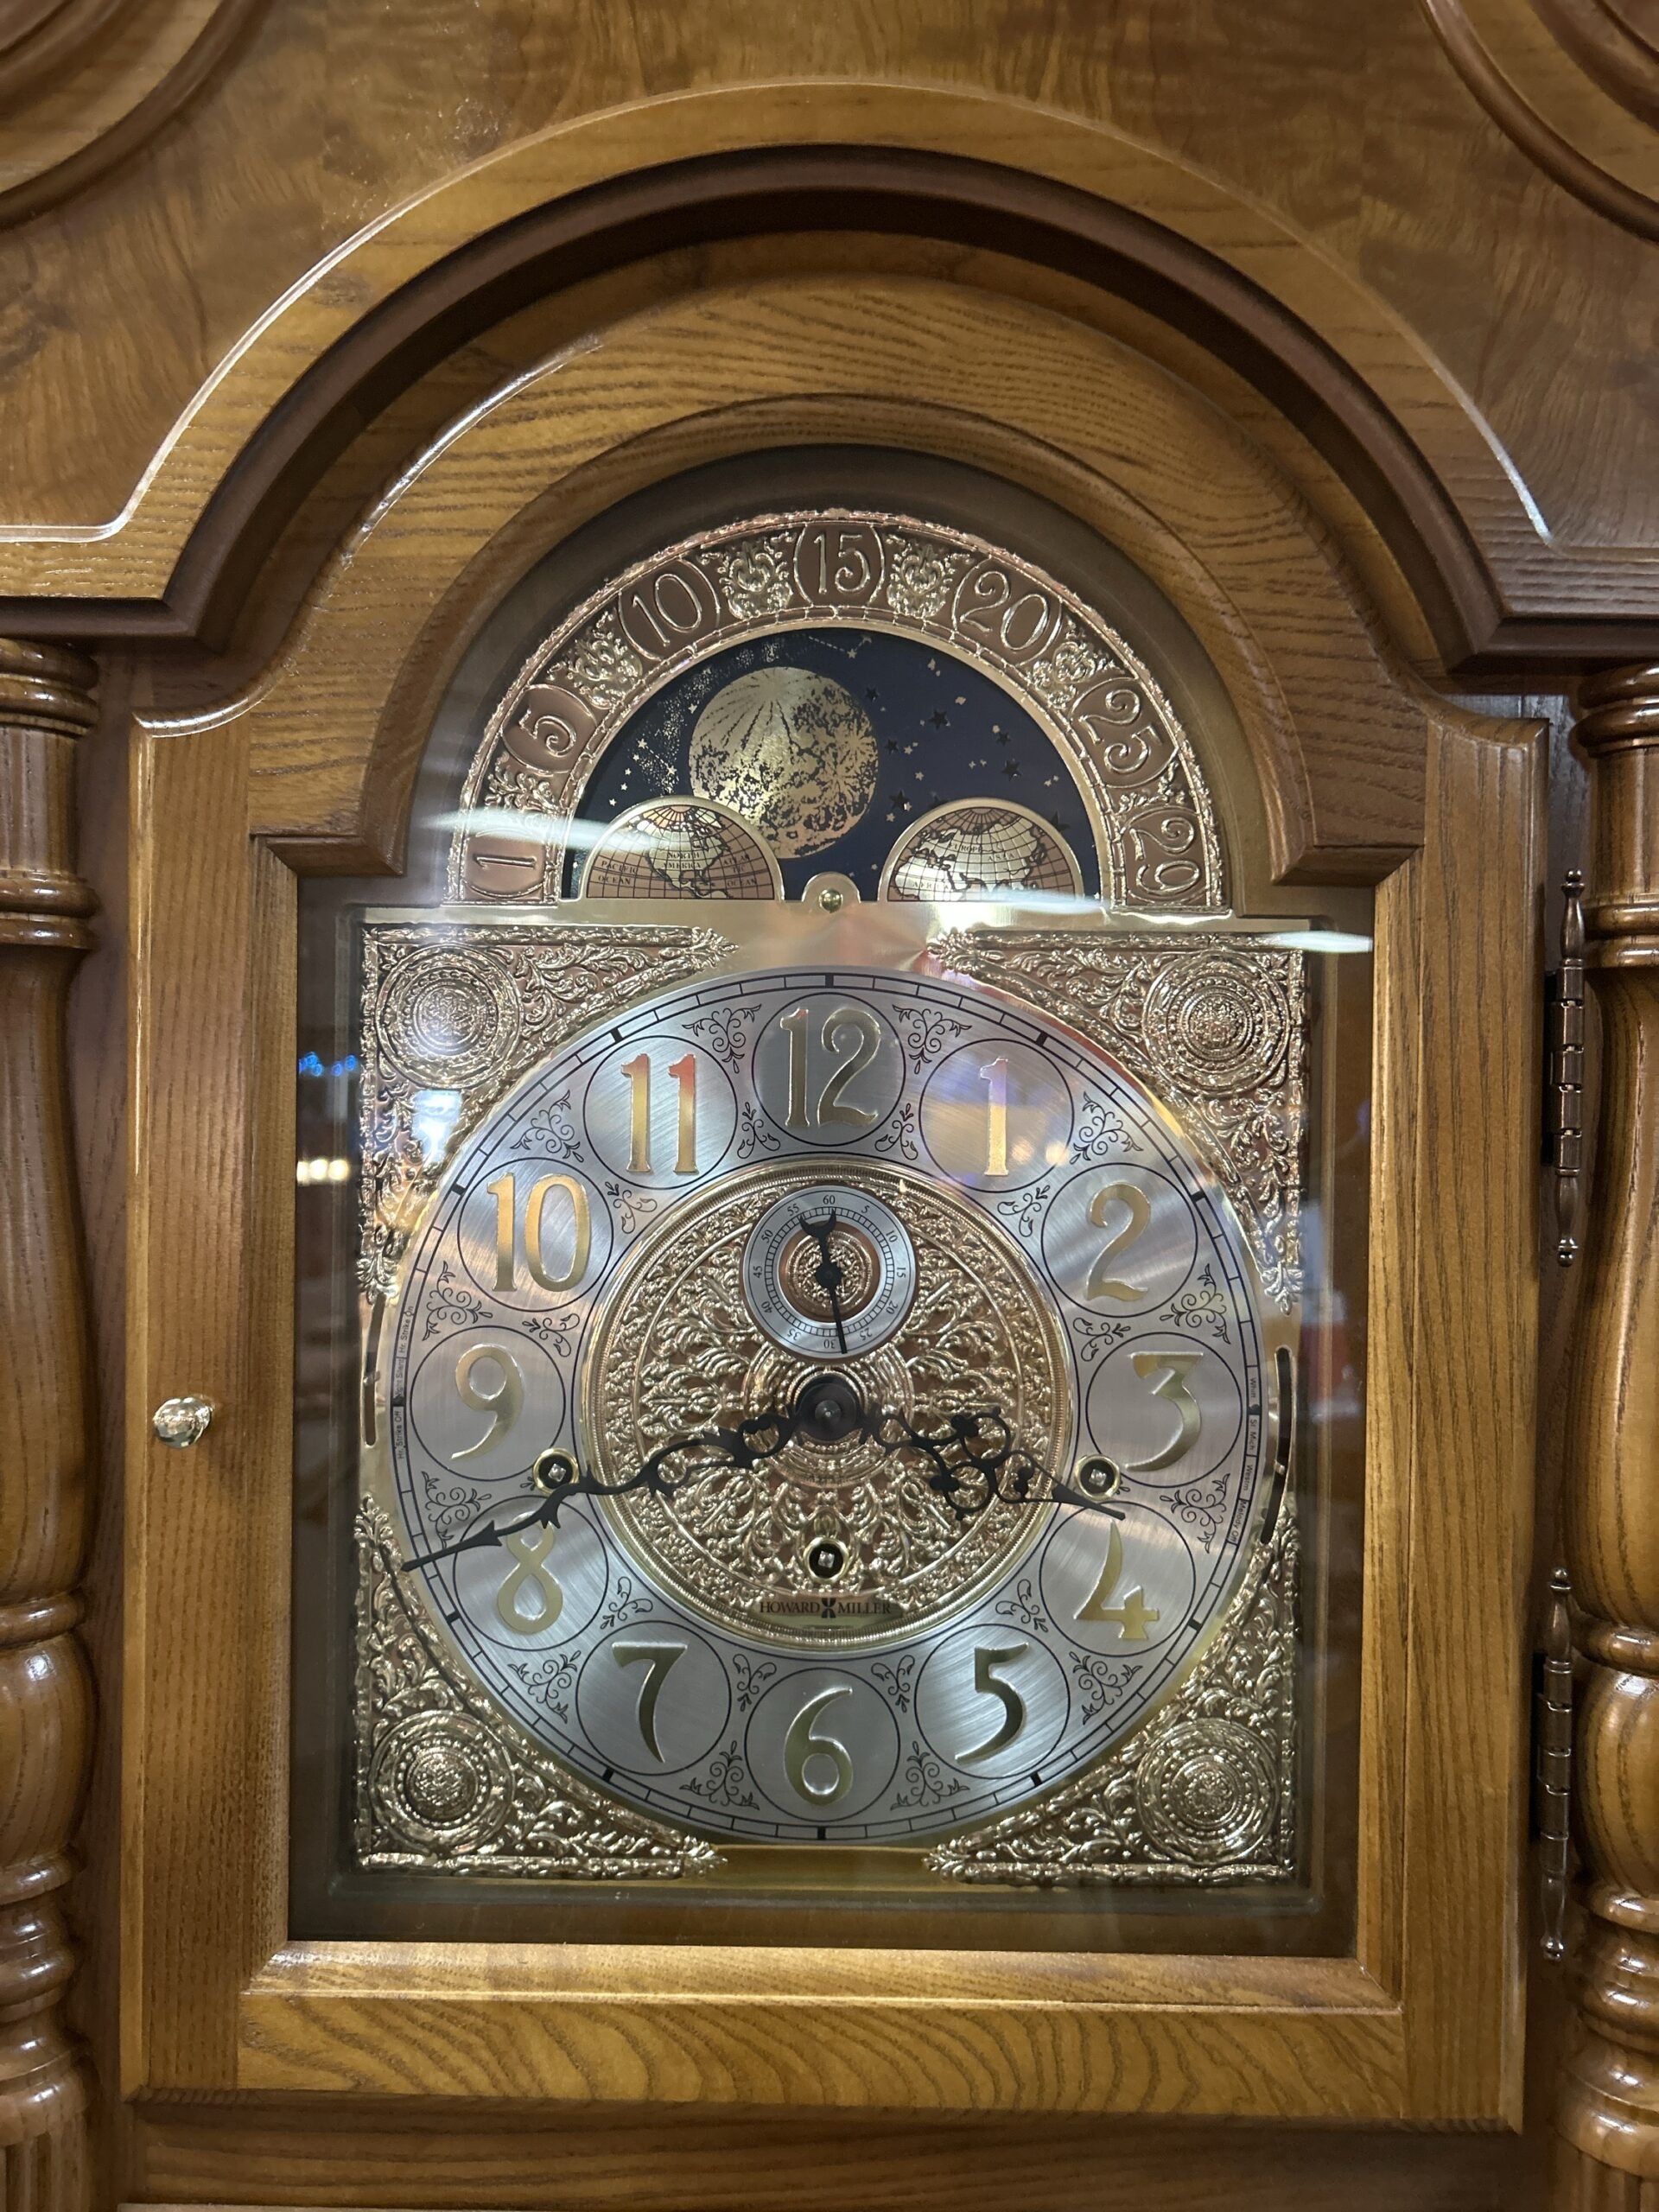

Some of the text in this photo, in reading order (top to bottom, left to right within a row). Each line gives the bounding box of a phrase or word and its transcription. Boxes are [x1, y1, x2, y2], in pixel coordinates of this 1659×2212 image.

[813, 533, 871, 594] 15
[631, 571, 703, 648] 10
[958, 569, 1049, 652] 20
[518, 709, 578, 758] 5
[1077, 688, 1164, 775] 25
[662, 861, 702, 869] AMERICA
[667, 851, 700, 860] NORTH
[598, 874, 631, 886] OCEAN
[779, 1006, 881, 1127] 12
[620, 1052, 701, 1176] 11
[979, 1058, 1010, 1177] 1
[787, 1203, 800, 1217] 55
[823, 1194, 836, 1205] 60
[861, 1205, 870, 1214] 5
[486, 1172, 592, 1293] 10
[760, 1230, 773, 1244] 50
[885, 1229, 899, 1243] 10
[1085, 1180, 1152, 1301] 2
[753, 1265, 763, 1279] 45
[896, 1266, 906, 1279] 15
[760, 1300, 773, 1314] 40
[886, 1301, 899, 1315] 20
[400, 1319, 410, 1340] Strike
[787, 1328, 801, 1341] 35
[860, 1327, 873, 1341] 25
[823, 1338, 836, 1350] 30
[450, 1343, 526, 1460] 9
[1123, 1351, 1205, 1472] 3
[394, 1410, 403, 1422] Off
[395, 1424, 404, 1447] Strike
[1235, 1499, 1247, 1529] Melody
[497, 1510, 563, 1635] 8
[1073, 1516, 1160, 1640] 4
[760, 1601, 891, 1614] HOWARD MILLER
[612, 1642, 690, 1764] 7
[953, 1641, 1029, 1765] 5
[783, 1686, 855, 1806] 6
